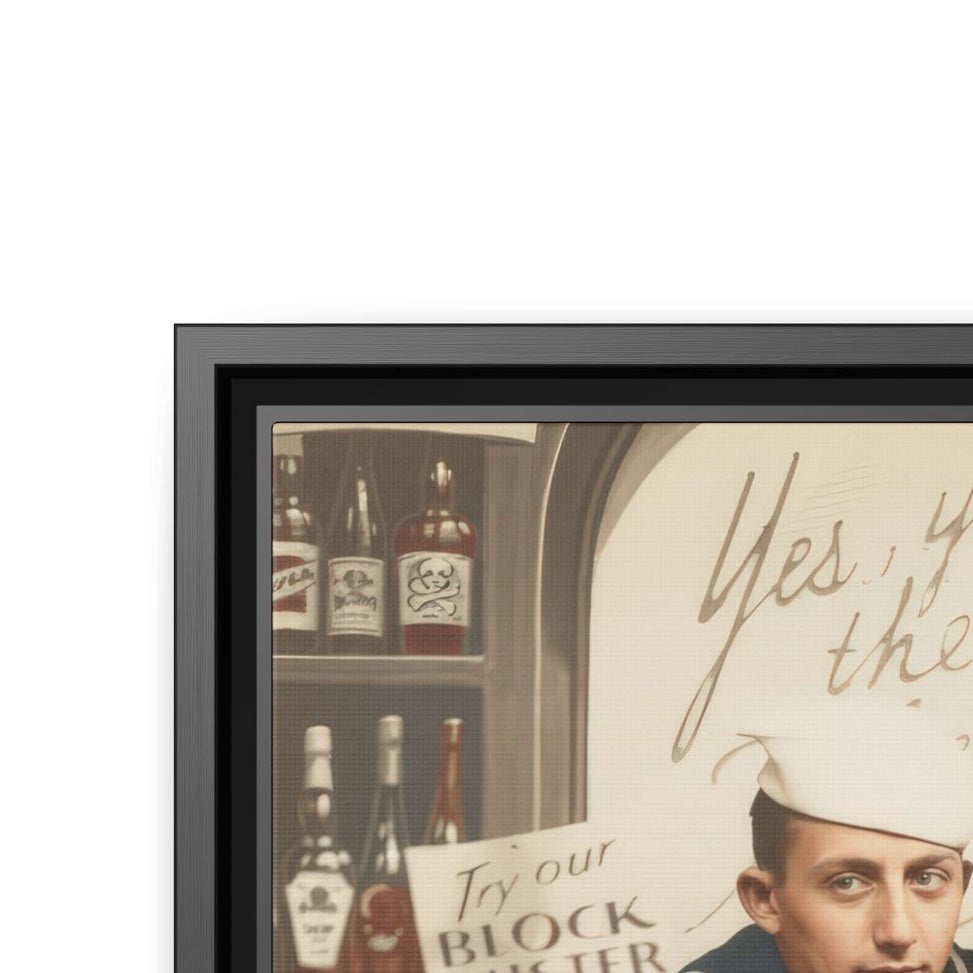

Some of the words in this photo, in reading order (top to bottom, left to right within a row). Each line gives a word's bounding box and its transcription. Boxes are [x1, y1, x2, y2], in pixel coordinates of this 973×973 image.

[826, 575, 973, 697] the
[456, 860, 519, 923] Try
[535, 838, 617, 886] our
[437, 895, 657, 969] BLOCK
